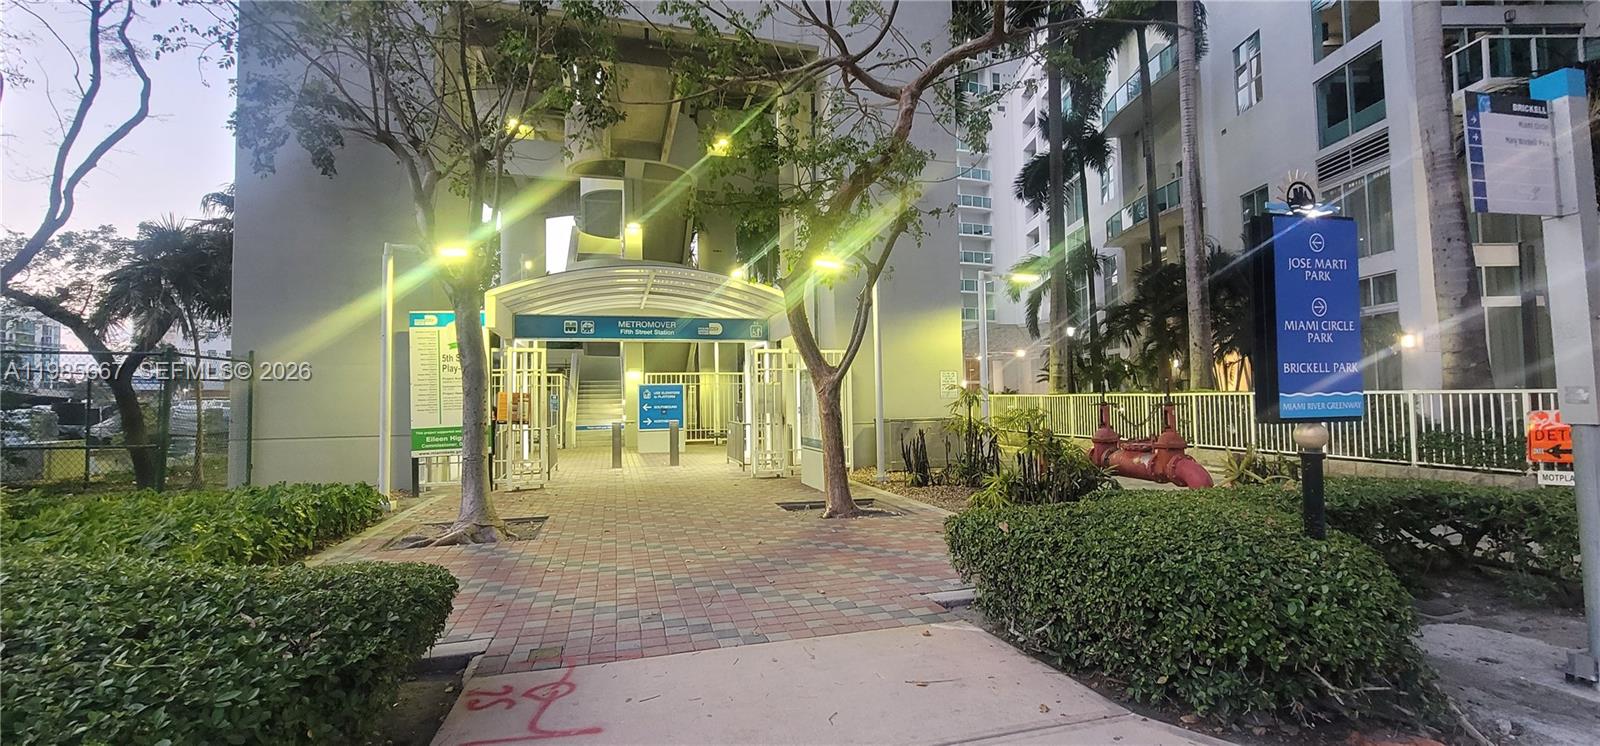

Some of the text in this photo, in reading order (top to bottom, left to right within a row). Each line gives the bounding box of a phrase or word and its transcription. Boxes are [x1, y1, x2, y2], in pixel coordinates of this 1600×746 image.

[1512, 104, 1547, 114] BRICKELL
[1288, 257, 1347, 270] JOSE MARTI
[1305, 270, 1331, 281] PARK
[1284, 320, 1355, 331] MIAMI CIRCLE
[1307, 332, 1334, 343] PARK
[442, 354, 454, 362] 5th
[1283, 362, 1359, 374] BRICKELL PARK
[1282, 401, 1362, 411] MIAMI RIVER GREENWAY
[1535, 429, 1572, 441] DET
